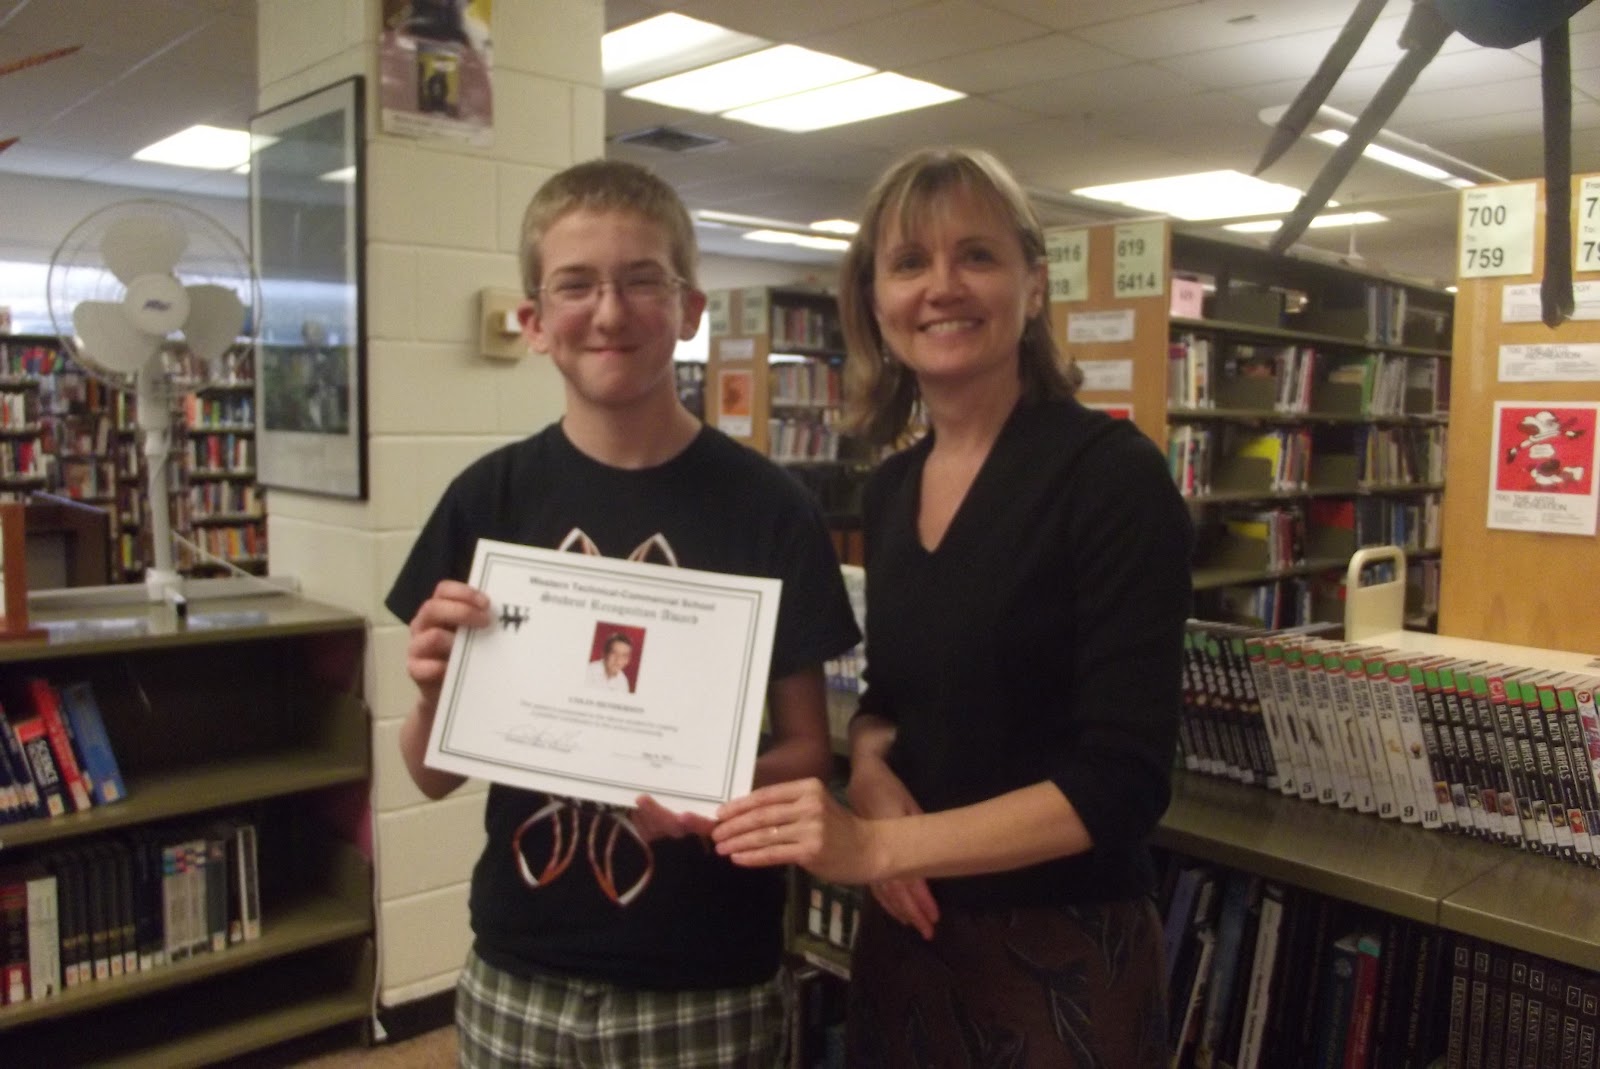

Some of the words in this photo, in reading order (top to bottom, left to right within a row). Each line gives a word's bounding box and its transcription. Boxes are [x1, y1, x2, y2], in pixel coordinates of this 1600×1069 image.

[1468, 205, 1506, 228] 700
[1117, 239, 1145, 257] 619
[1466, 247, 1504, 269] 759
[1536, 742, 1553, 776] BARRELS
[1554, 746, 1571, 780] BARRELS
[1284, 778, 1293, 789] 4
[1302, 782, 1312, 794] 5
[1342, 792, 1351, 803] 7
[1381, 803, 1391, 814] 8
[1404, 806, 1414, 817] 9
[1423, 809, 1438, 822] 10
